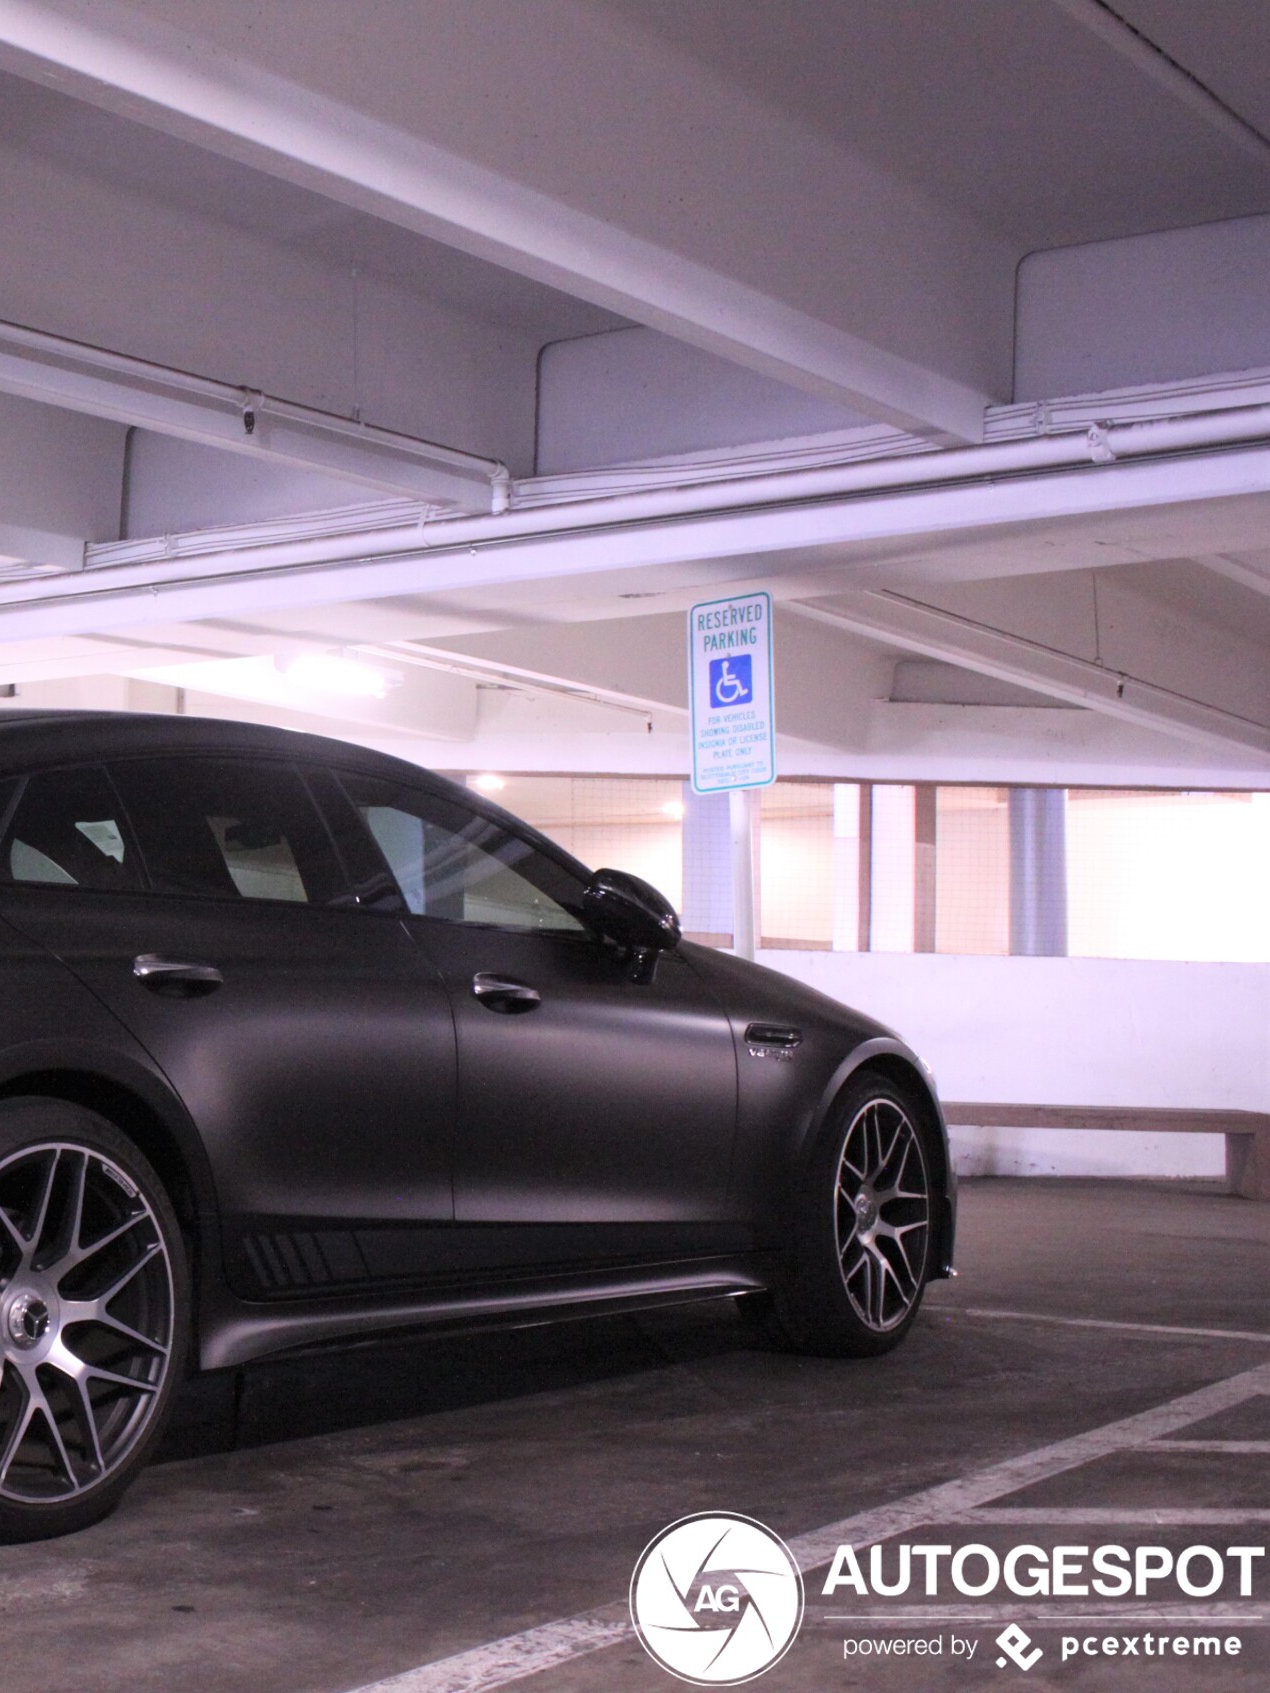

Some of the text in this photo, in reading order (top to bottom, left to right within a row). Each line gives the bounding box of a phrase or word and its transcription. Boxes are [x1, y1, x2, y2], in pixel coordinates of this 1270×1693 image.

[698, 604, 762, 631] RESERVED
[703, 627, 757, 652] PARKING
[708, 711, 756, 725] FOR VEHICLES
[700, 721, 765, 738] SHOWING DISABLED
[739, 732, 767, 744] LICENSE
[713, 747, 753, 759] PLATE ONLY
